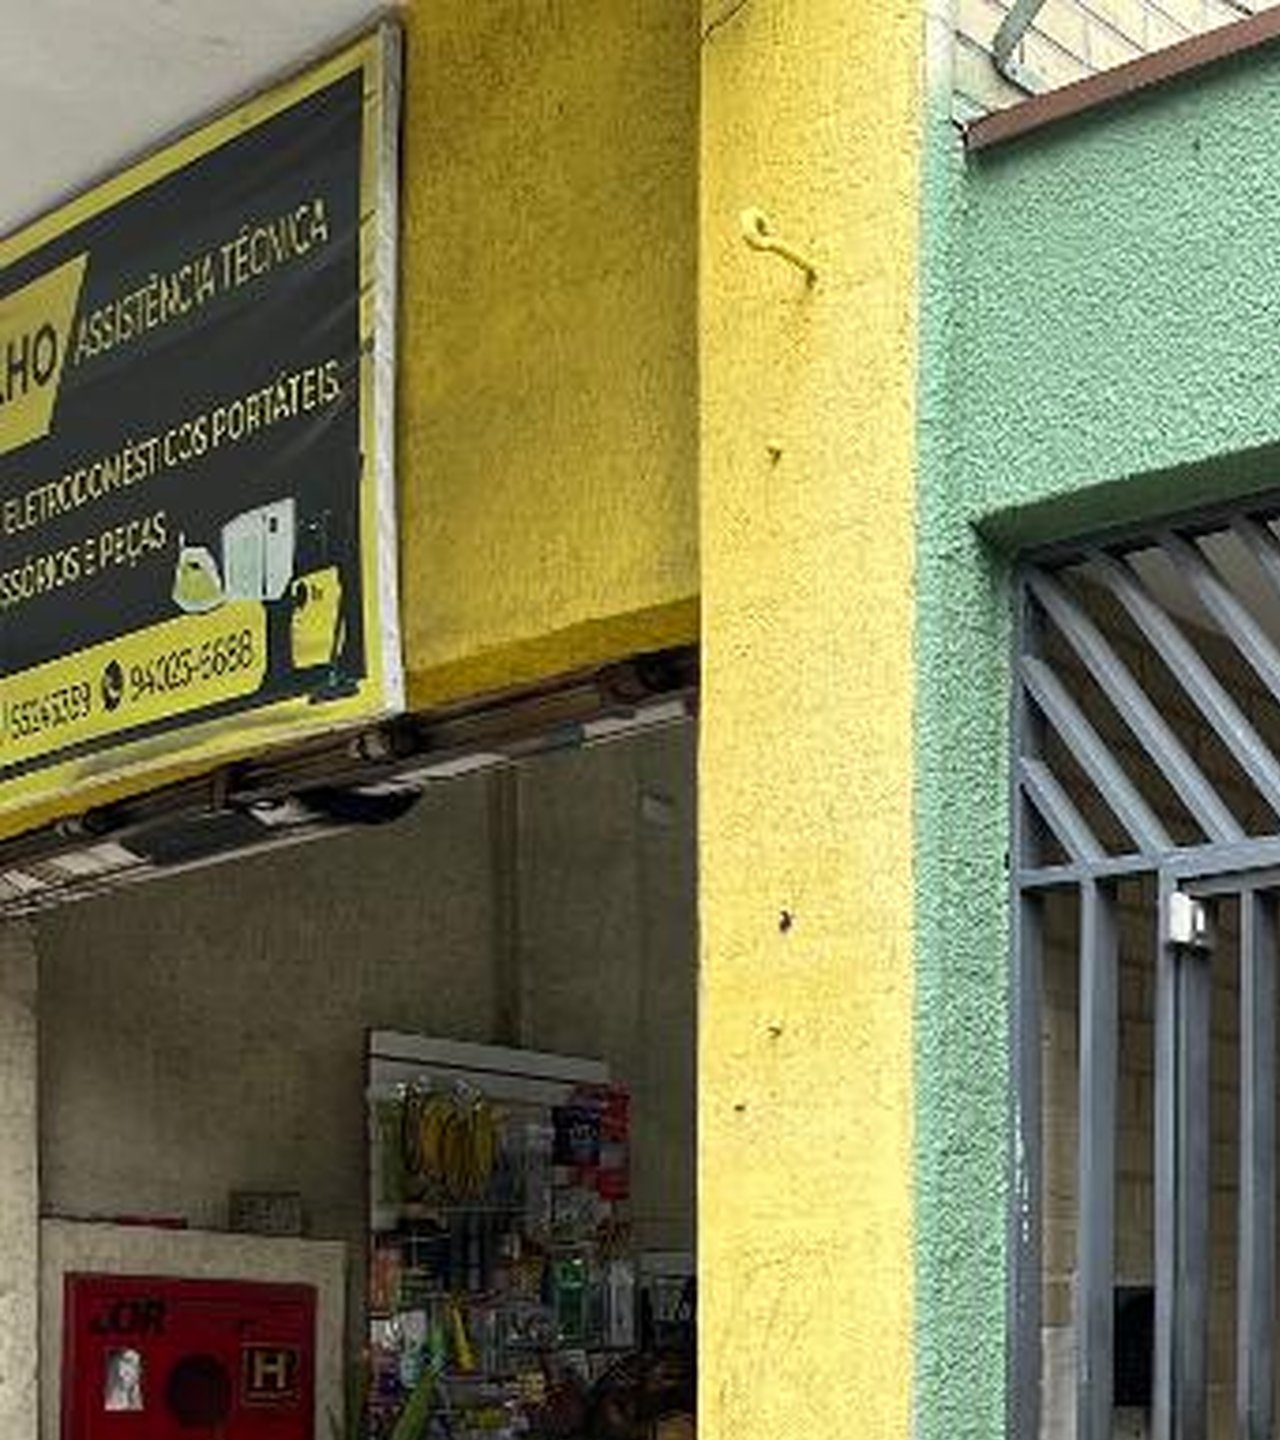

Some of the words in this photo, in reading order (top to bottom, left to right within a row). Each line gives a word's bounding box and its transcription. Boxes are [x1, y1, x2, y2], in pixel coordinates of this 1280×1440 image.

[73, 252, 216, 366] ASSISTÊNCIA
[220, 198, 329, 293] TÉCNICA
[0, 322, 58, 406] HO
[211, 357, 342, 449] PORTÁTEIS
[101, 510, 168, 569] PEÇAS
